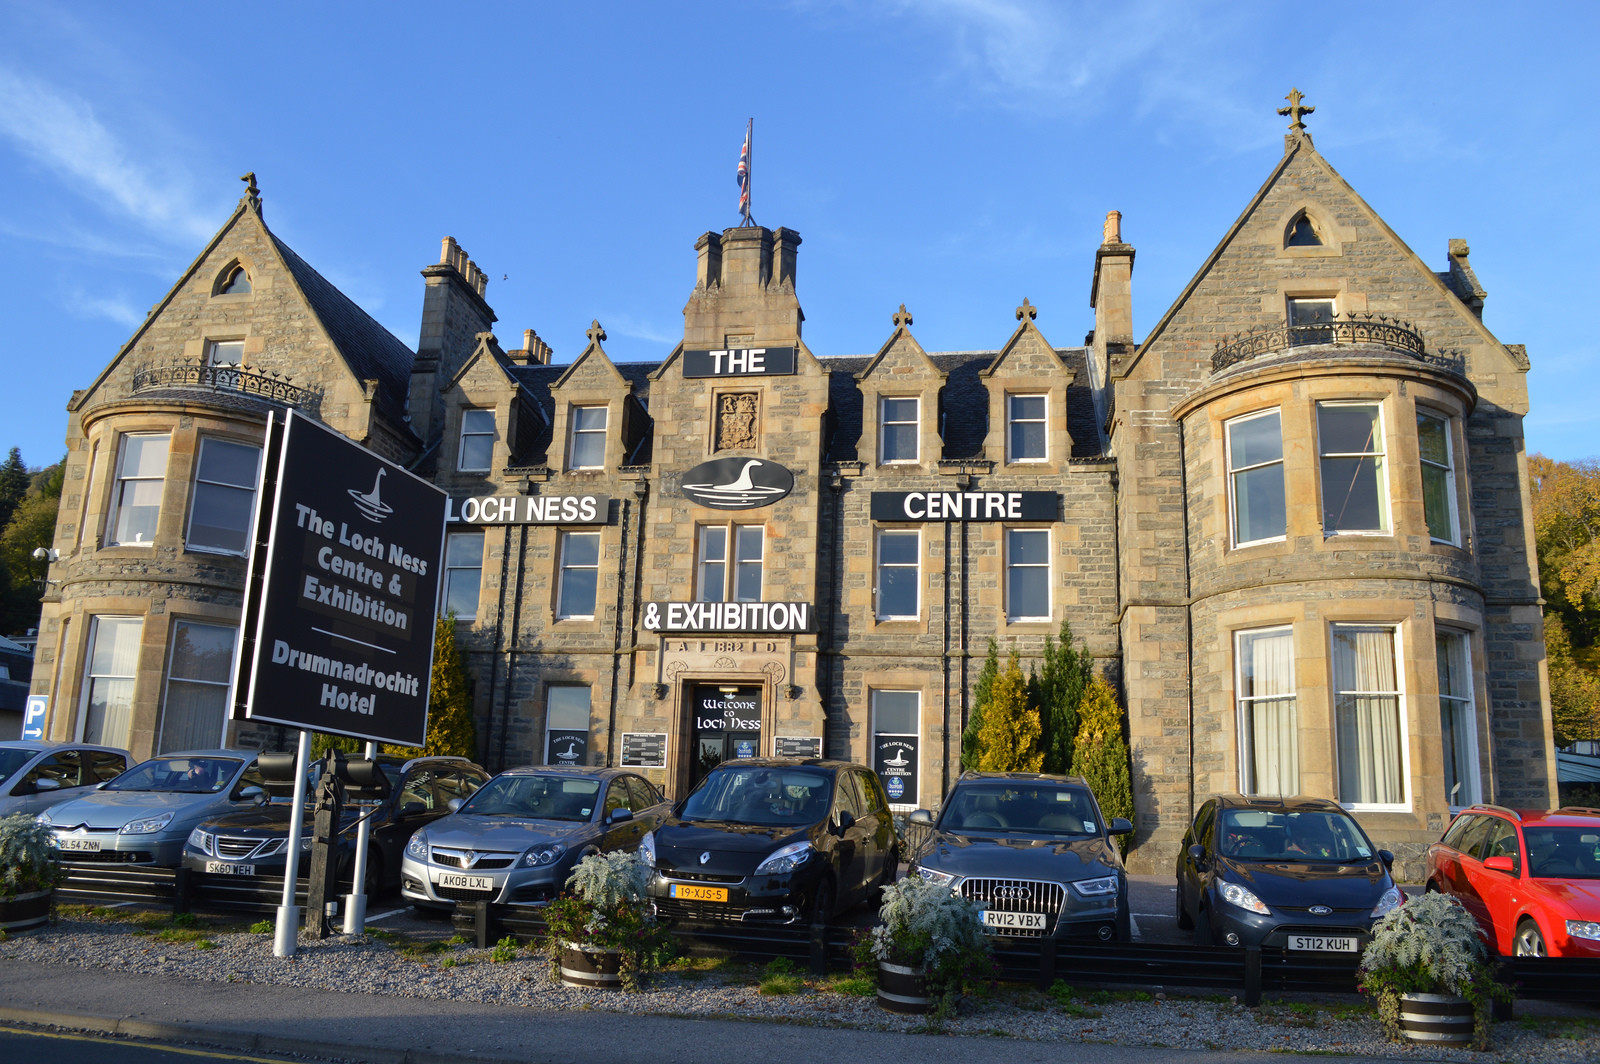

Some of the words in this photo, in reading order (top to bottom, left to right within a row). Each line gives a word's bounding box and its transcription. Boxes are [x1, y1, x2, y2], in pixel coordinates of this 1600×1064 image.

[709, 348, 766, 374] THE
[447, 497, 516, 523] LOCH
[526, 497, 597, 522] NESS
[903, 492, 1023, 519] CENTRE
[296, 502, 335, 540] The
[339, 522, 384, 559] Loch
[388, 543, 428, 577] Ness
[317, 546, 383, 589] Centre
[388, 574, 402, 597] &
[302, 574, 407, 630] Exhibition
[644, 602, 662, 630] &
[667, 602, 807, 630] EXHIBITION
[271, 639, 419, 697] Drumnadrochit
[26, 700, 46, 724] P
[320, 683, 376, 716] Hotel
[697, 716, 726, 729] Loch
[731, 717, 761, 729] Ness
[60, 840, 81, 850] BL54
[209, 863, 231, 874] SK60
[232, 865, 251, 875] WEH
[443, 876, 468, 887] AK08
[469, 878, 488, 889] LXL
[679, 887, 723, 900] 19-XJS-5
[987, 912, 1015, 925] RV12
[1018, 914, 1041, 927] VBX
[1296, 937, 1324, 950] ST12
[1327, 939, 1351, 951] KUH
